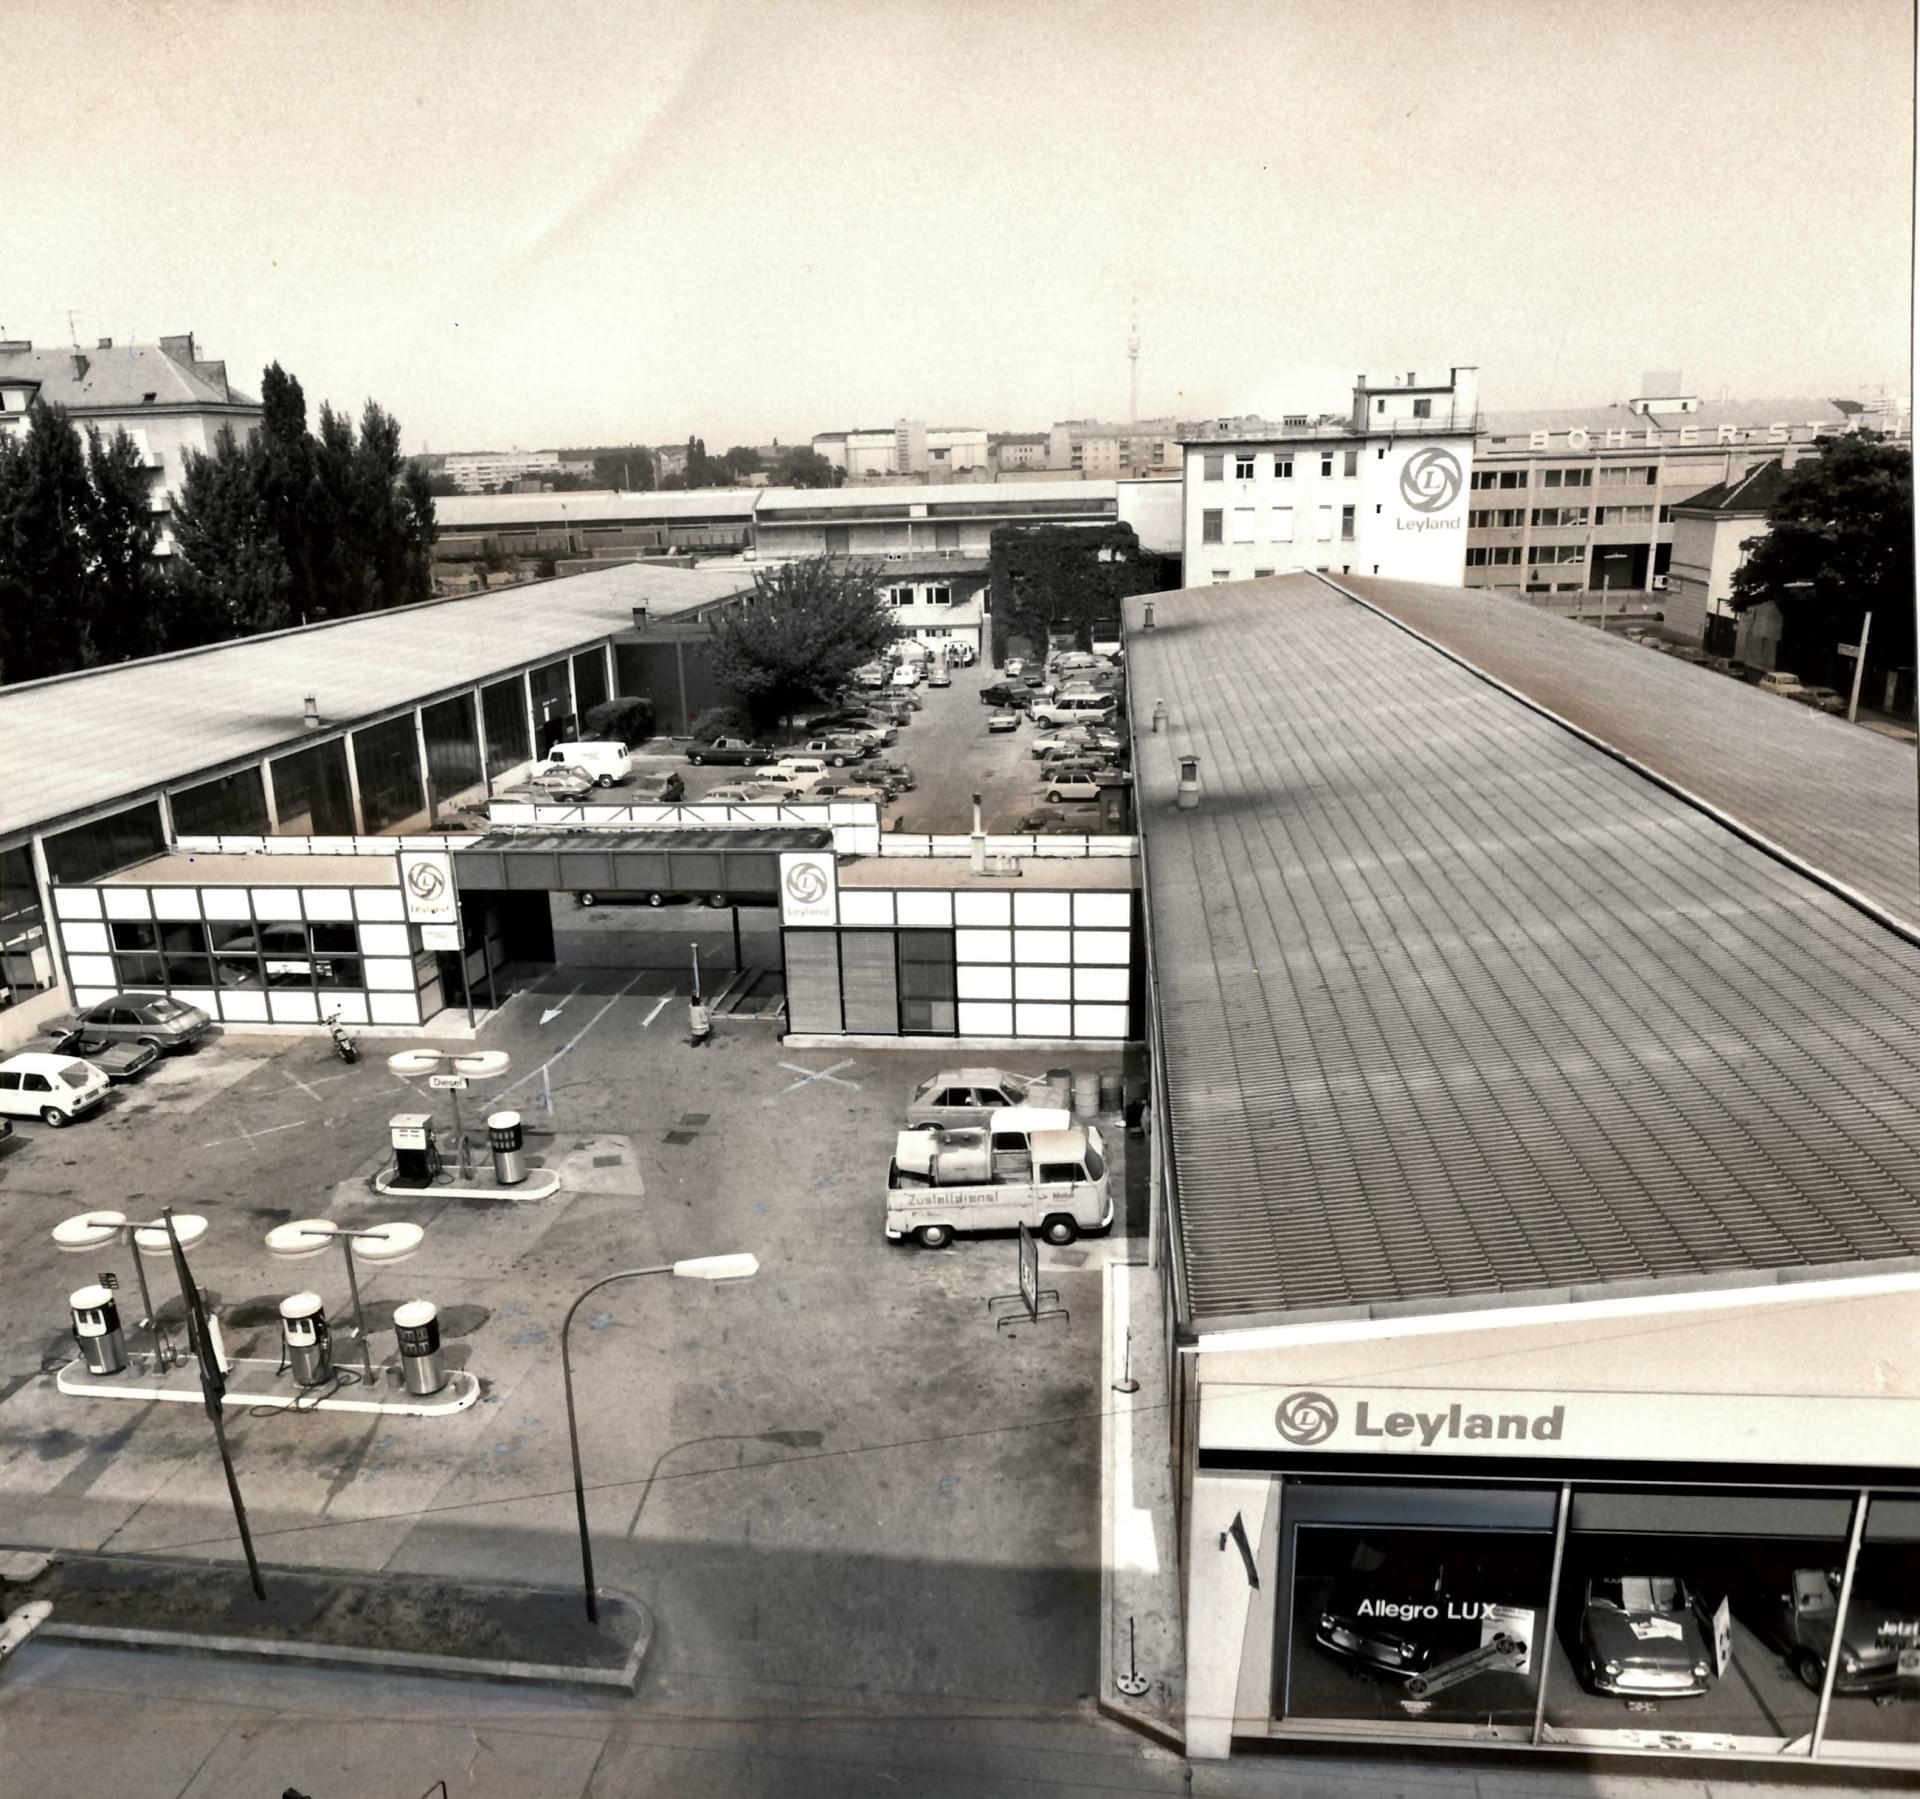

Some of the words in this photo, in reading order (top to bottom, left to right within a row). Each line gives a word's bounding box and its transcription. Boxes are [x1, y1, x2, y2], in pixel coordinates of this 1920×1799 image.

[1396, 516, 1461, 533] Leyland
[433, 1077, 463, 1087] Diesel
[907, 1191, 999, 1206] Zustelldienst
[1355, 1401, 1566, 1447] Leyland
[1357, 1599, 1439, 1622] Allegro
[1447, 1602, 1497, 1620] LUX
[1877, 1620, 1919, 1636] Jetzt
